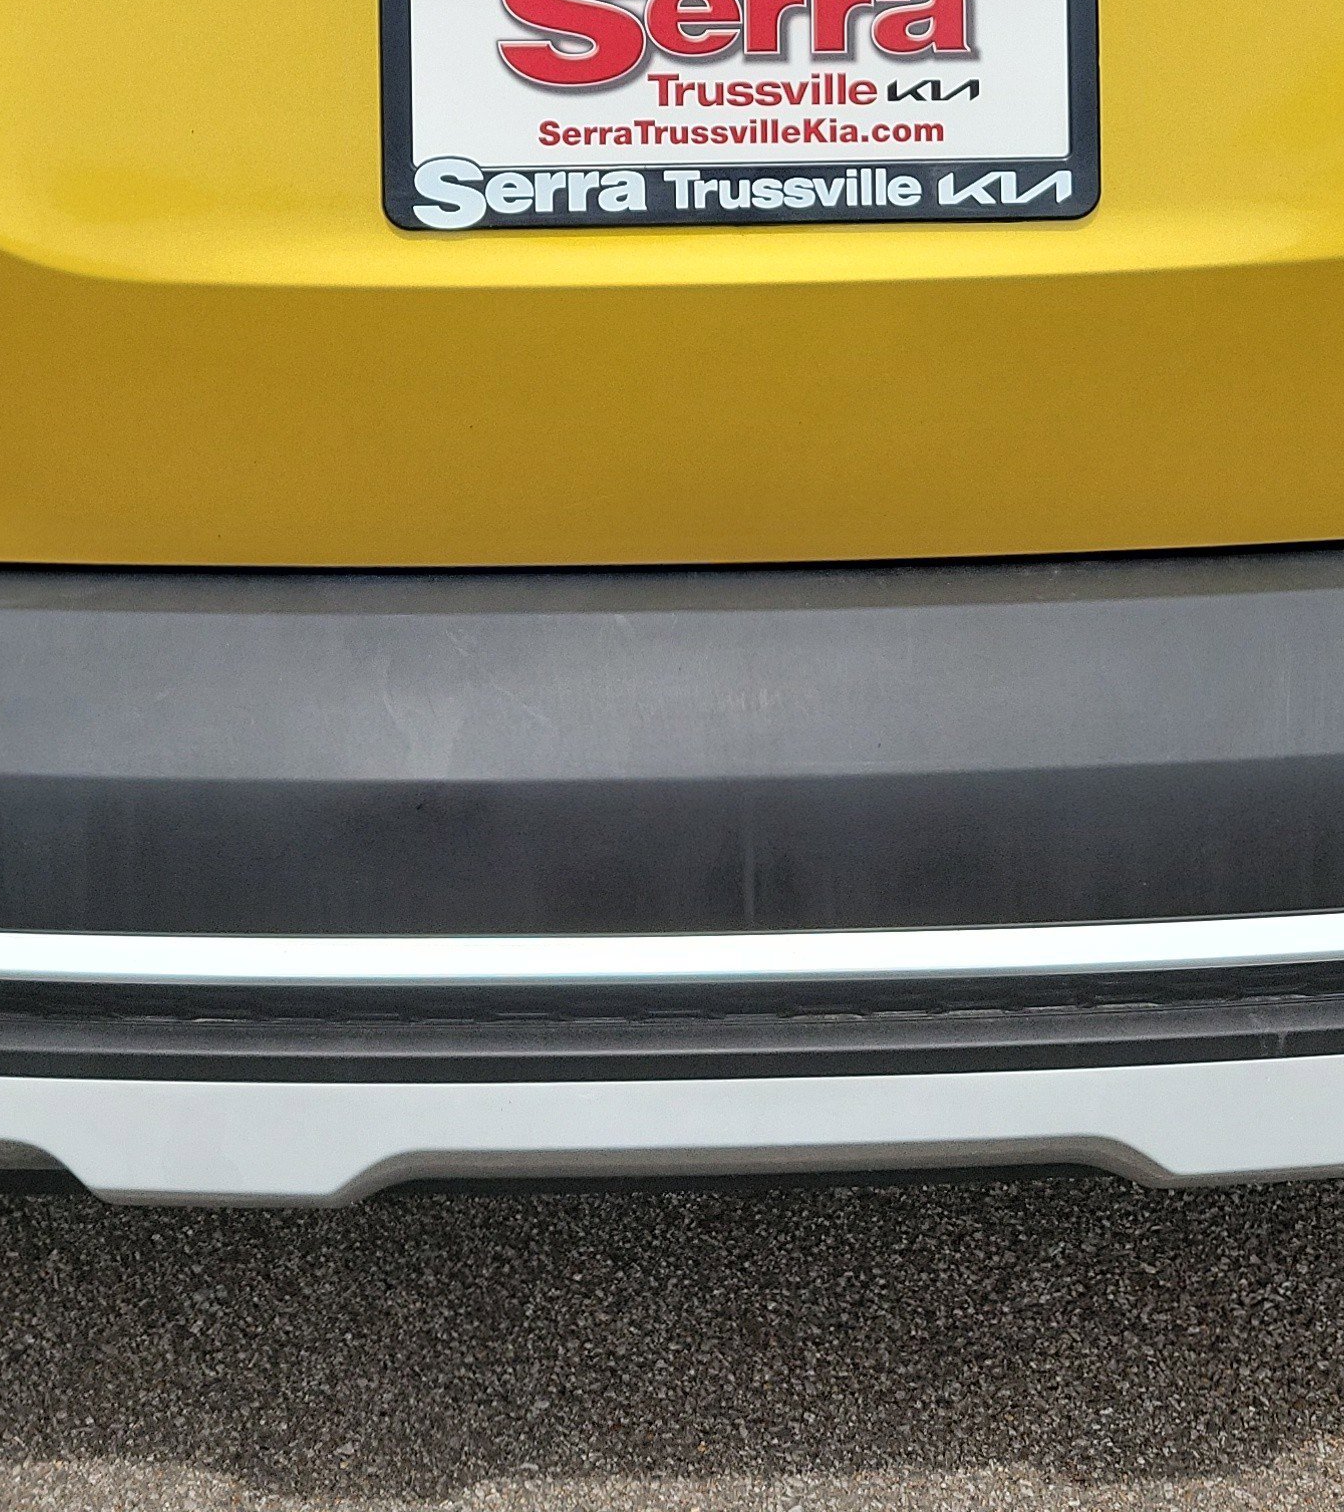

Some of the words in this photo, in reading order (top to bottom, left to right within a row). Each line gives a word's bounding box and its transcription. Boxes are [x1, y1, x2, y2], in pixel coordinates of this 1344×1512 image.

[647, 73, 878, 107] Trussville
[887, 78, 980, 102] KIA
[538, 117, 945, 148] SerraTrussvilleKia.com
[414, 155, 648, 229] Serra
[663, 169, 923, 210] Trussville
[937, 169, 1073, 207] KIA
